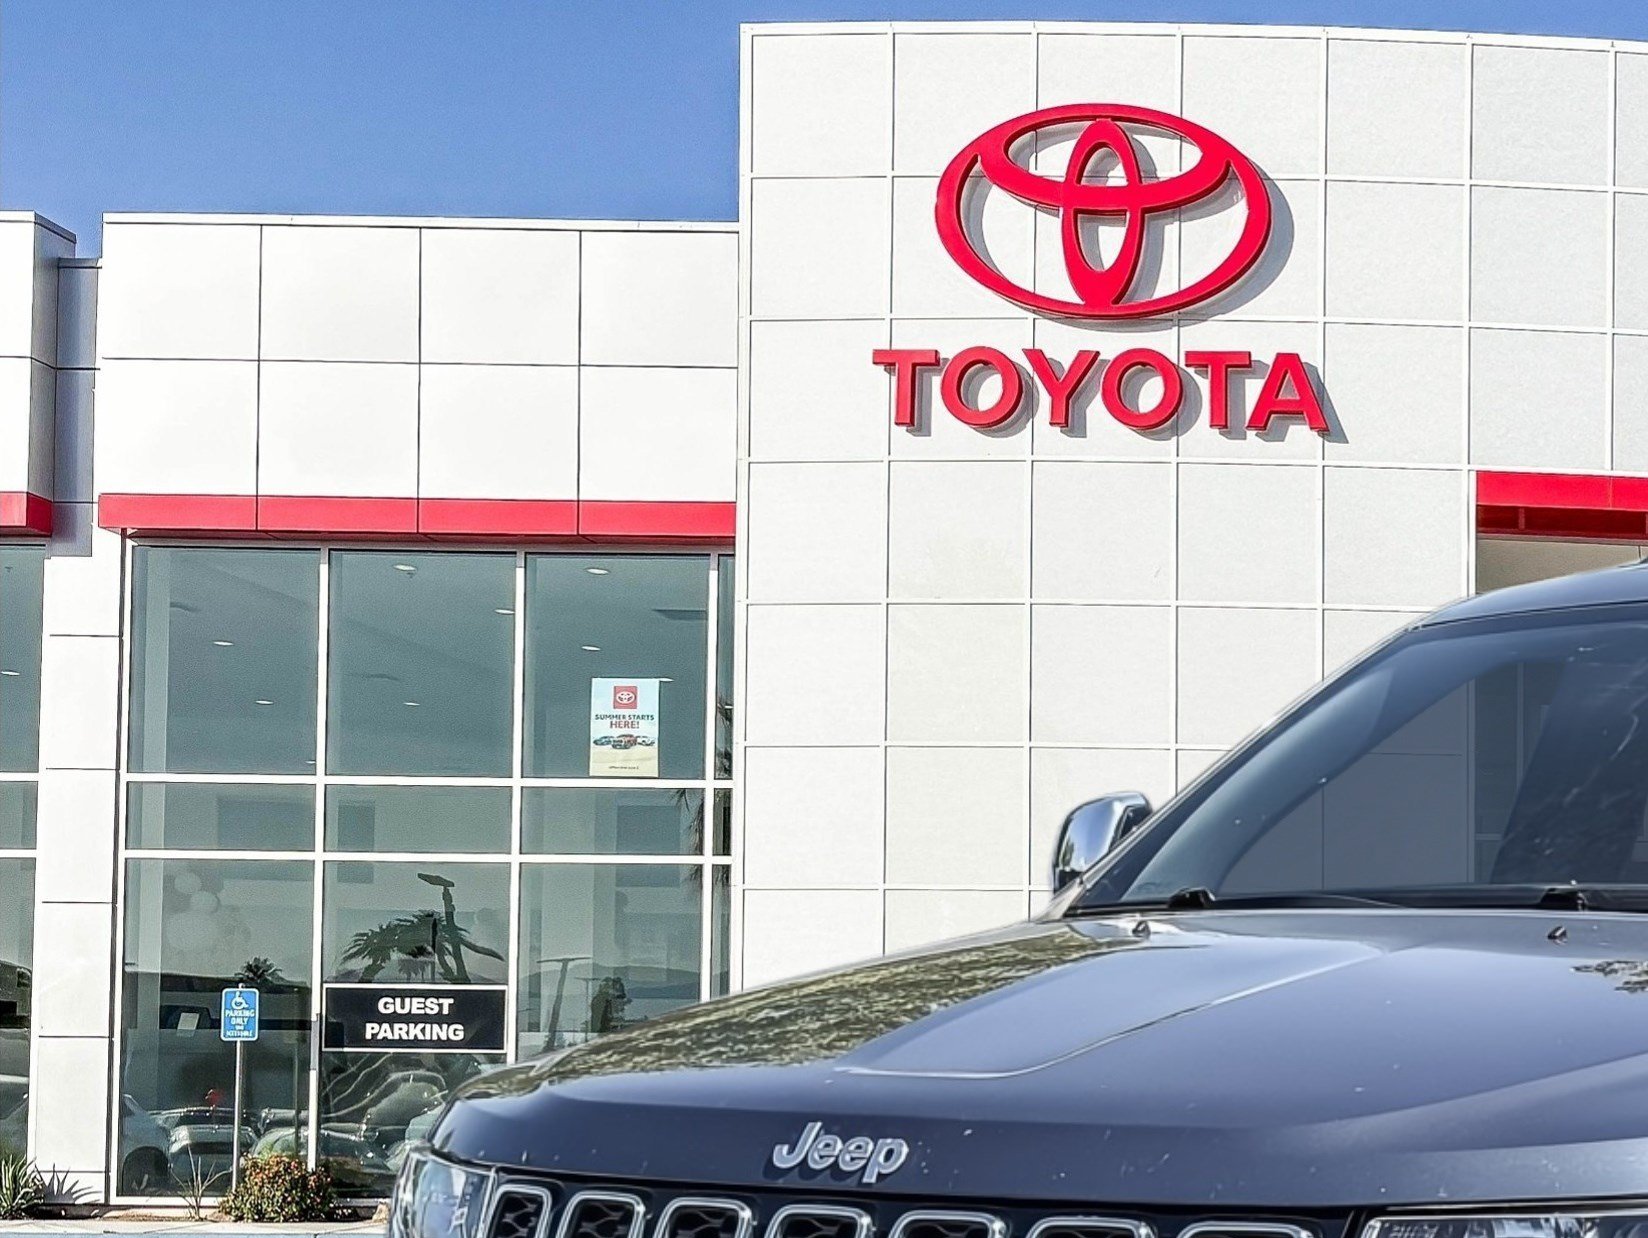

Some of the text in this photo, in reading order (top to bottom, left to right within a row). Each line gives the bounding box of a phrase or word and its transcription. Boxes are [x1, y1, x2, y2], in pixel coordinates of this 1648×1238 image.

[872, 345, 1330, 433] TOYOTA
[610, 720, 640, 729] HERE!
[377, 997, 454, 1015] GUEST
[364, 1022, 465, 1041] PARKING
[772, 1120, 910, 1184] Jeep
